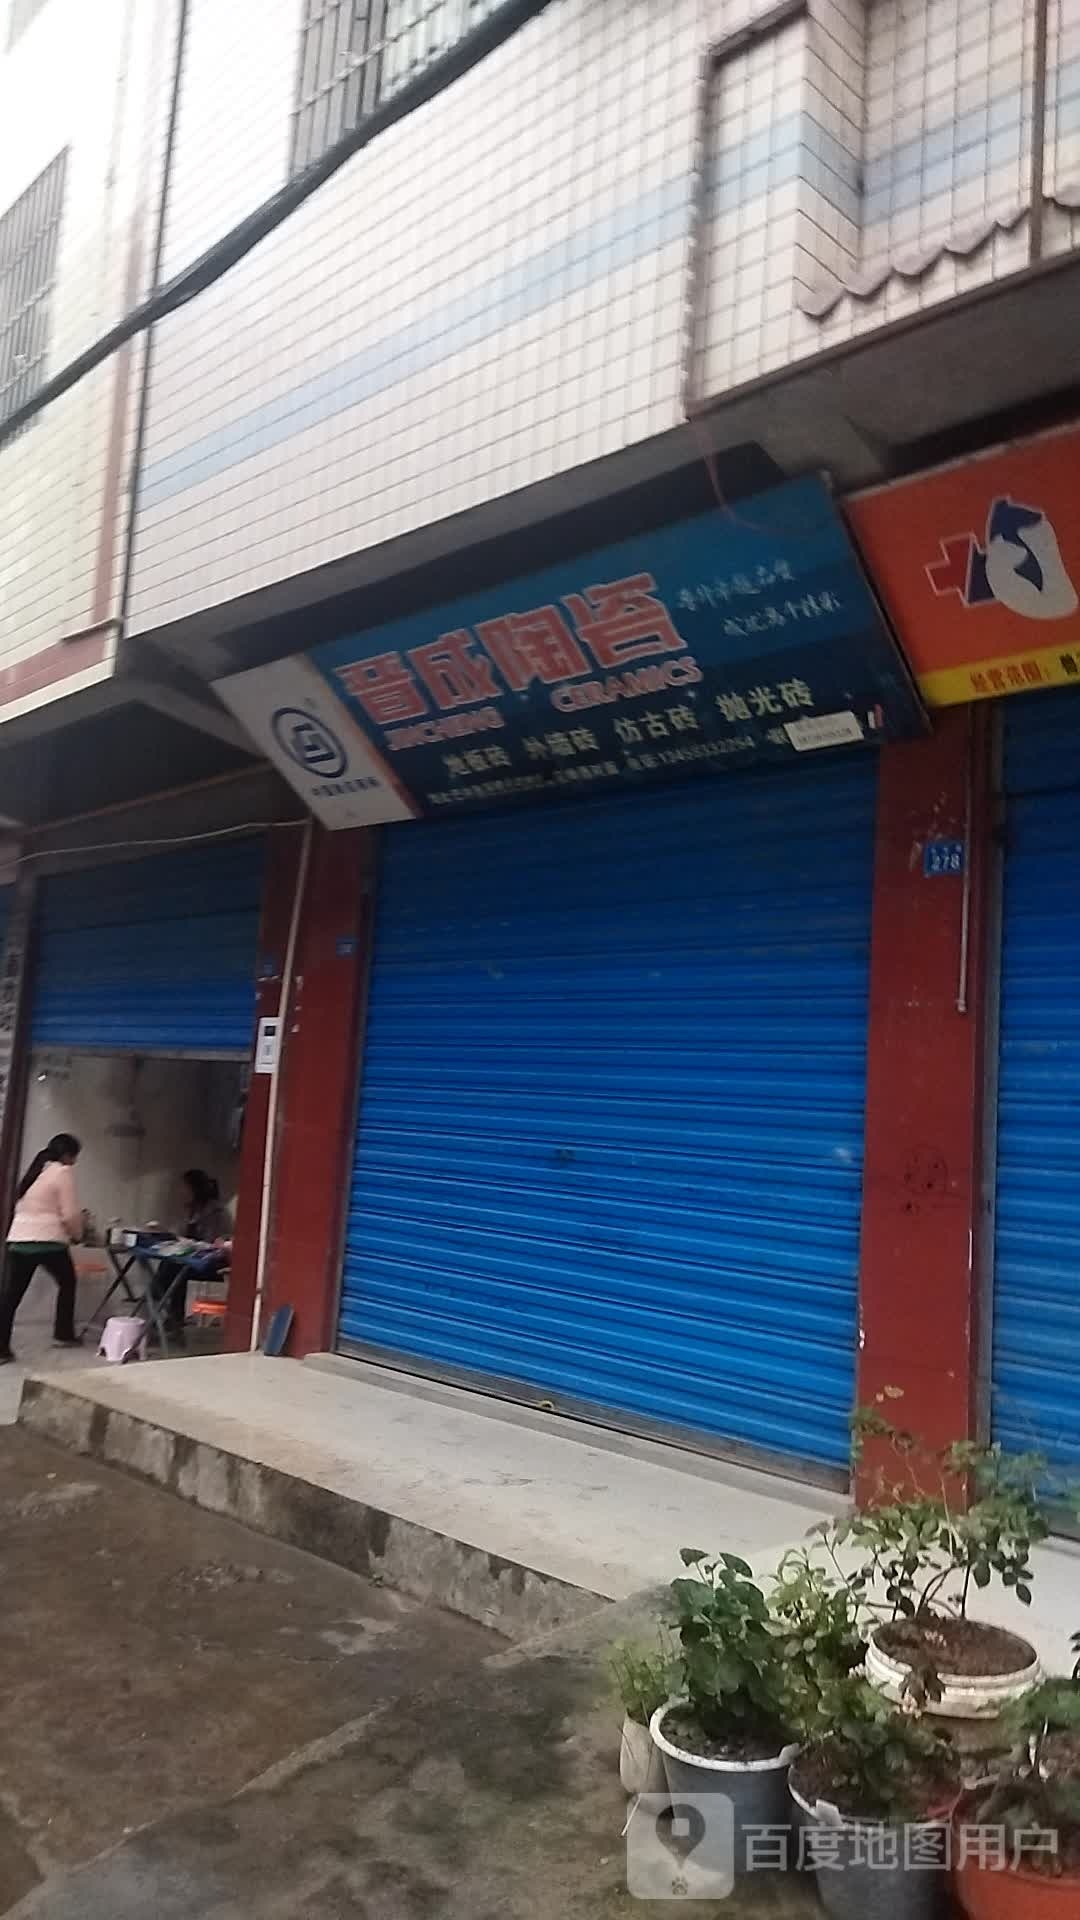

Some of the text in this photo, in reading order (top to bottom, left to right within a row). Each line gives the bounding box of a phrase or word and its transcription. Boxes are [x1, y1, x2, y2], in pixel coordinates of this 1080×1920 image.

[339, 573, 688, 724] 晋成陶瓷
[552, 656, 703, 712] CERAMICS
[613, 704, 699, 744] 仿古砖
[716, 679, 813, 723] 抛光砖
